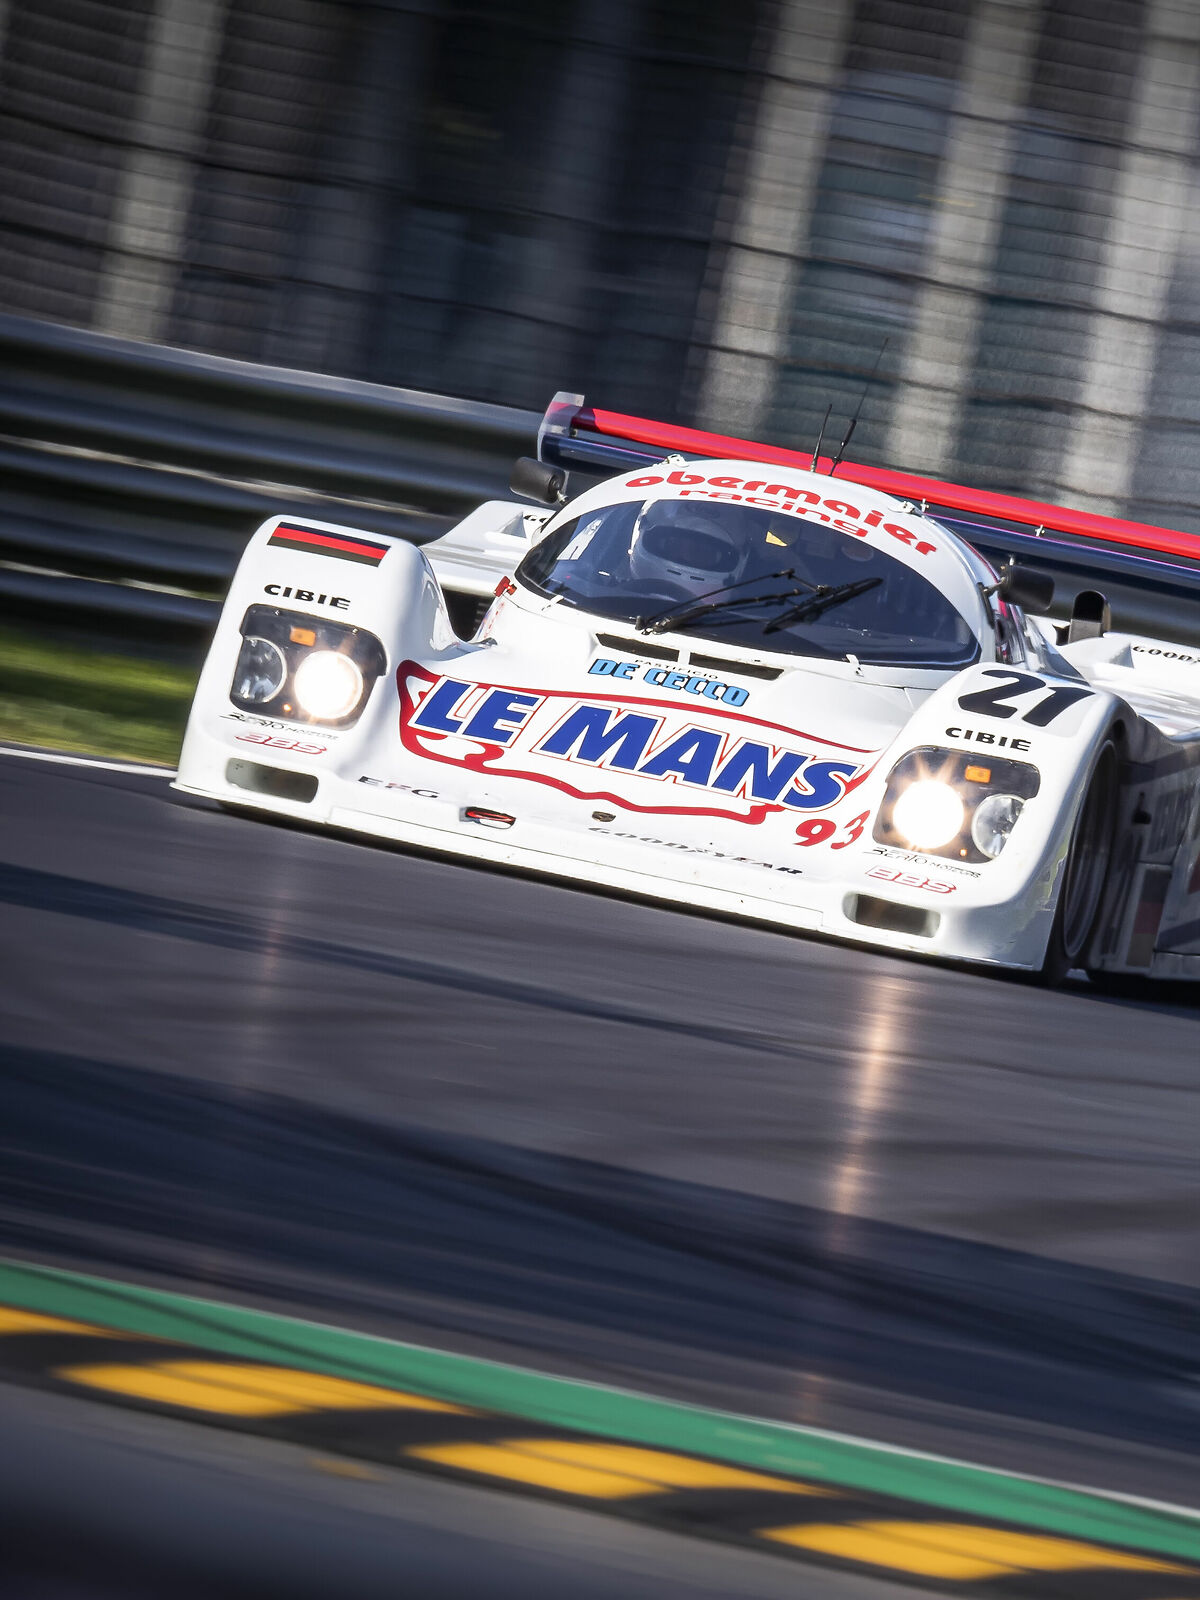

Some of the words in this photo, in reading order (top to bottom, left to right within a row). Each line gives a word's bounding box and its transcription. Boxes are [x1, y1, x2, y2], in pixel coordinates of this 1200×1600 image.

[625, 471, 938, 556] obermaier
[679, 489, 869, 538] racing
[587, 658, 640, 680] DE
[643, 667, 750, 707] CECCO
[634, 659, 719, 679] PASTIFICIO
[957, 669, 1097, 728] 21
[235, 732, 328, 755] BBS
[410, 678, 542, 745] LE
[534, 703, 862, 810] MANS
[793, 809, 872, 851] 93
[865, 865, 957, 894] BBS
